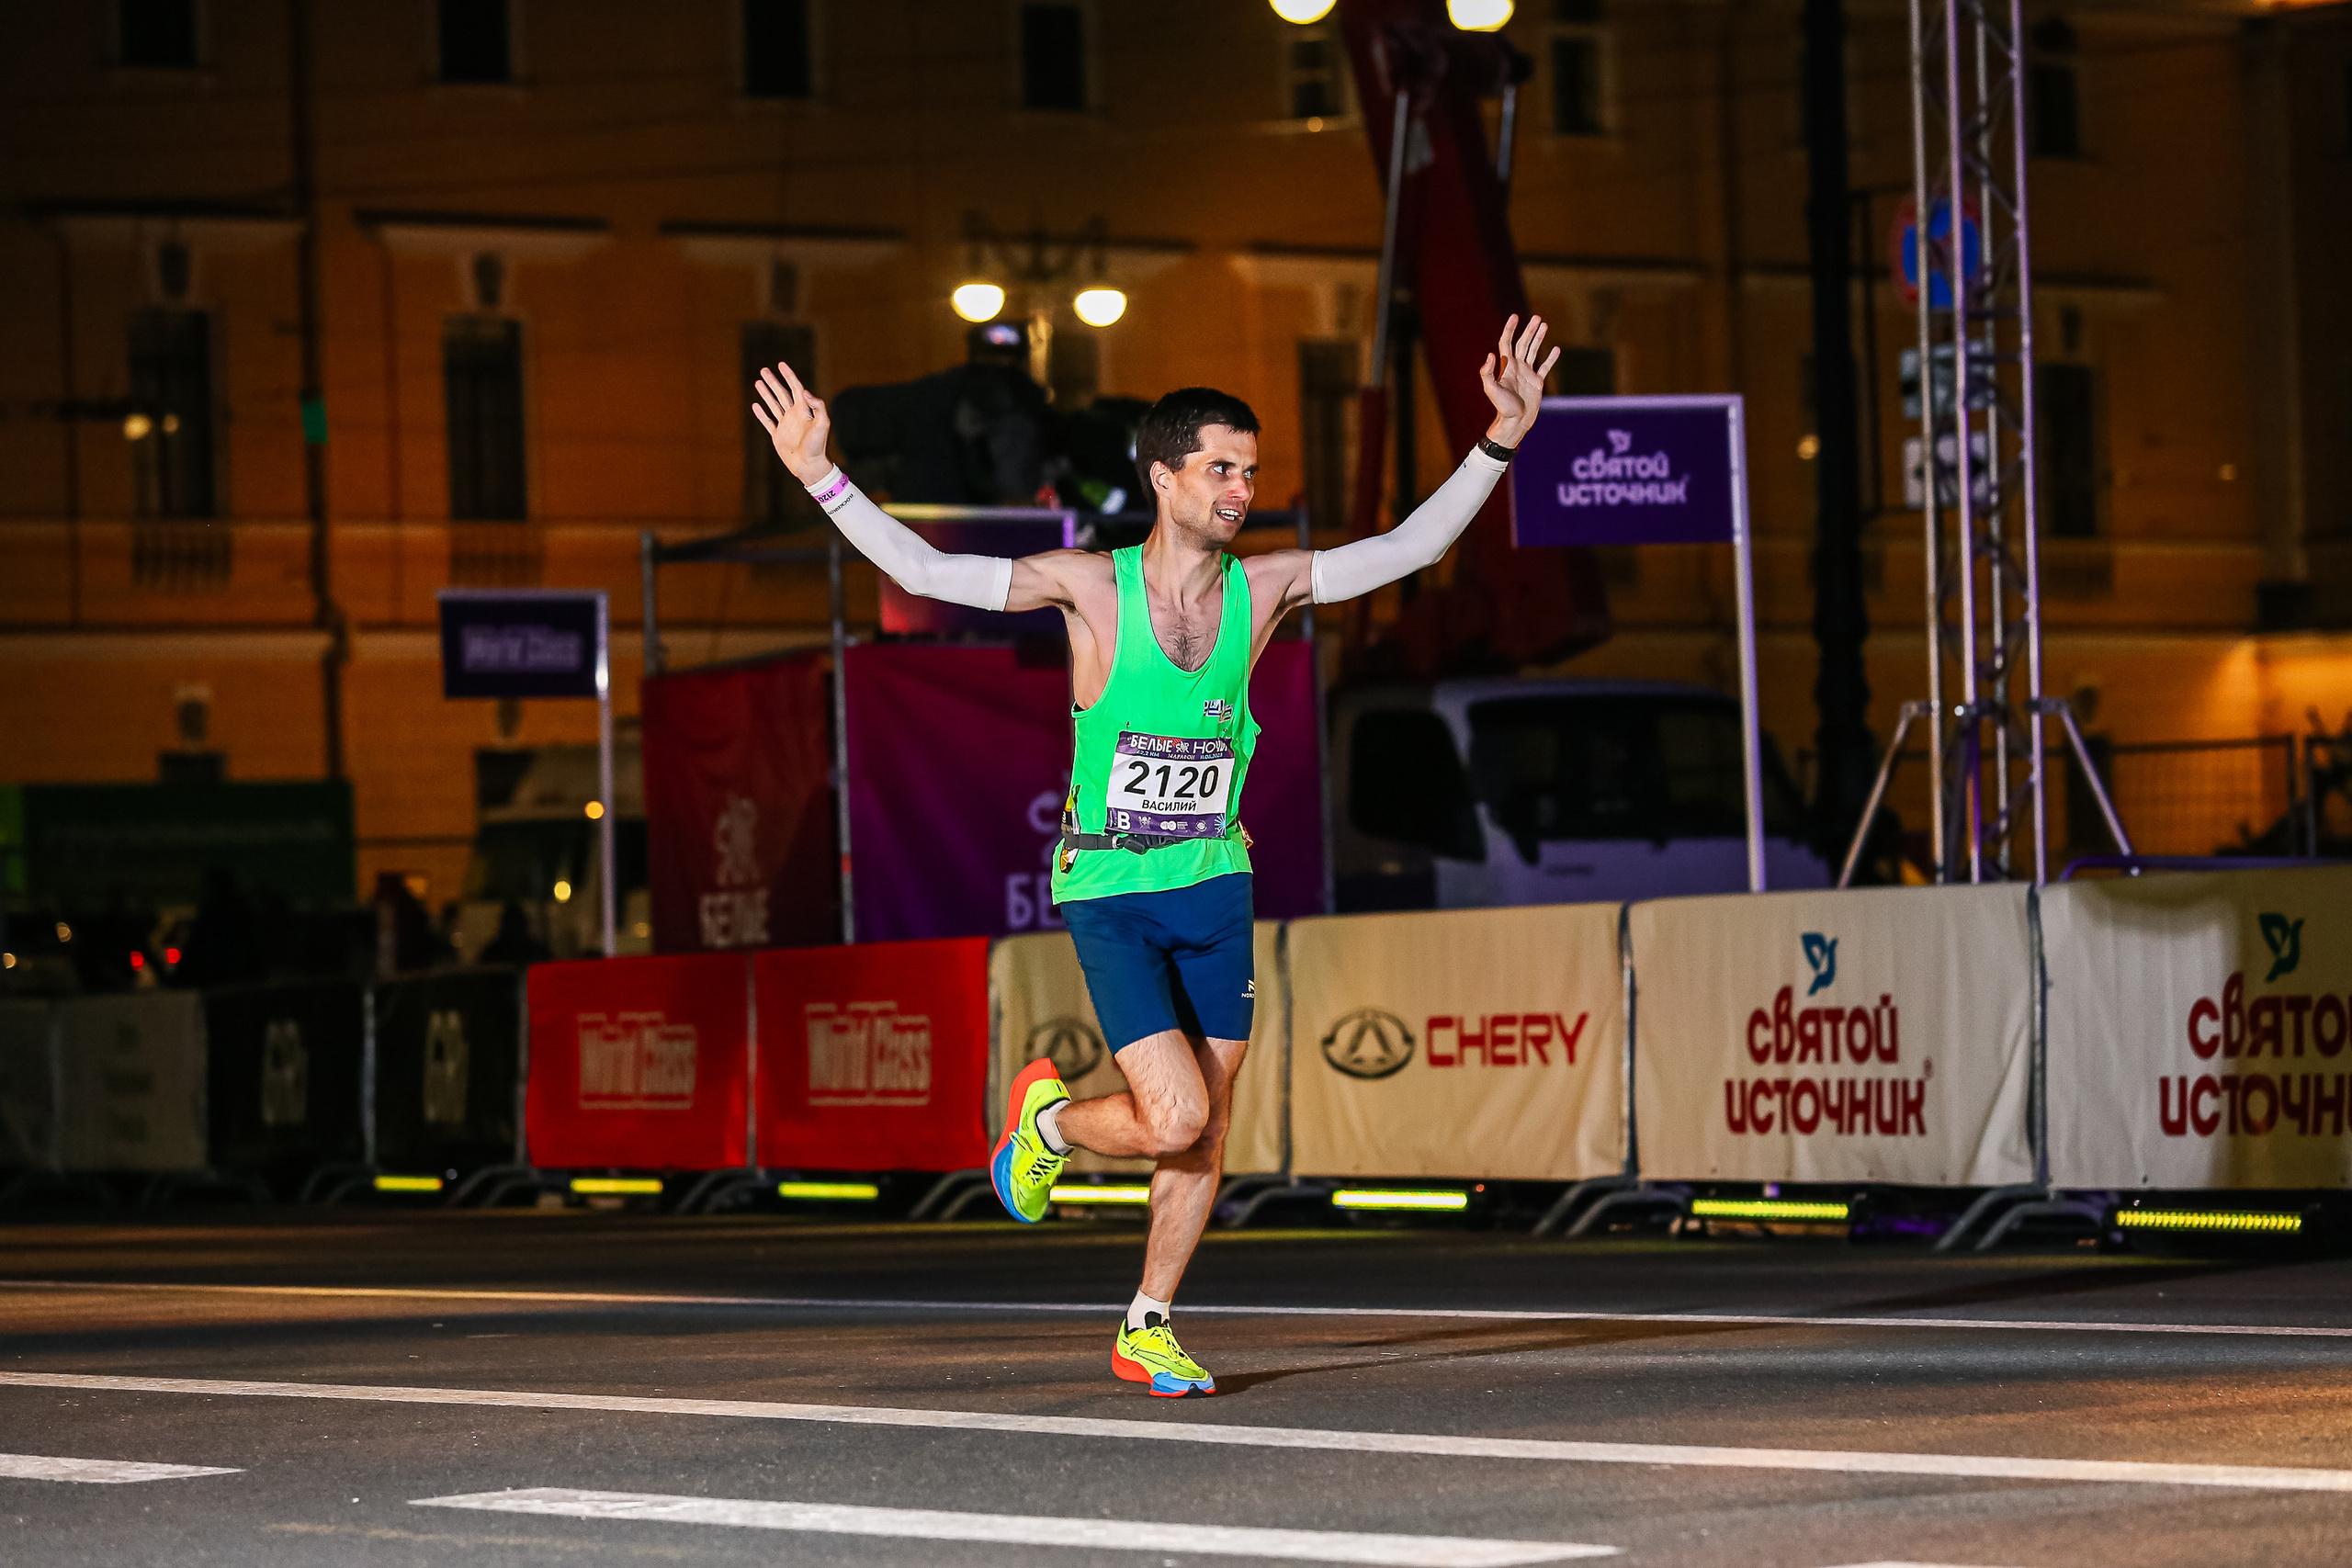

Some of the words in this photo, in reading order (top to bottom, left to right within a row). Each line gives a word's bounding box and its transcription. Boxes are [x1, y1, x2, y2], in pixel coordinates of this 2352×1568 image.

[818, 490, 836, 502] 2120
[1130, 734, 1172, 753] БЕЛЫЕ
[1124, 761, 1219, 798] 2120
[1141, 799, 1197, 811] ВАСИЛИЙ
[1427, 1011, 1589, 1067] CHERY
